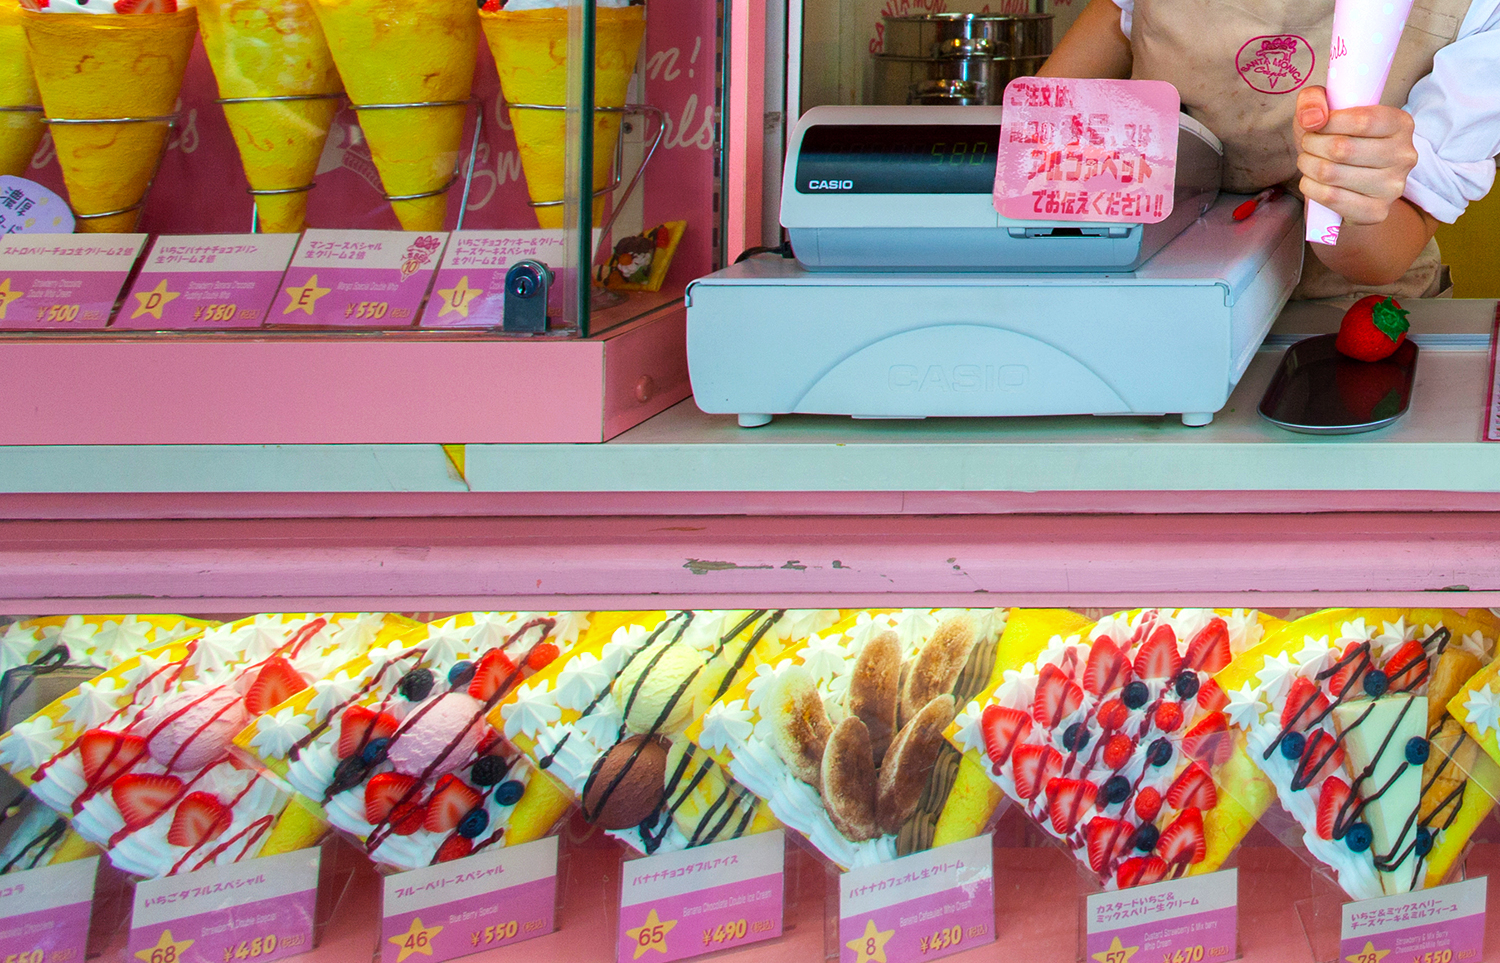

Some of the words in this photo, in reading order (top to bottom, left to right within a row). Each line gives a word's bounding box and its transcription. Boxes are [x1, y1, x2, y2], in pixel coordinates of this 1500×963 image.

[1240, 57, 1271, 73] SANTA
[1273, 57, 1302, 84] MONICA
[928, 141, 988, 168] 580
[1028, 150, 1153, 184] アルファベット
[808, 178, 854, 191] CASIO
[3, 246, 135, 257] ストロベリーチョコ生クリーム2倍
[159, 245, 259, 255] いちごバナナチョコプリン
[305, 250, 365, 260] 生クリーム2倍
[309, 240, 382, 251] マンゴースペシャル
[455, 247, 537, 256] チーズケーキスペシャル
[155, 254, 216, 264] 生クリーム2倍
[451, 256, 507, 265] 生クリーム2倍
[145, 293, 162, 310] D
[298, 288, 313, 304] E
[451, 289, 466, 307] U
[36, 304, 80, 322] ¥500
[193, 304, 237, 322] ¥580
[345, 301, 388, 320] ¥550
[887, 363, 1030, 393] CASIO
[633, 855, 739, 886] バナナチョコダブルアイス
[850, 860, 964, 898] バナナカフェオレ生クリーム
[145, 874, 265, 908] いちごダブルスペシャル
[395, 865, 505, 898] ブルーベリースペシャル
[682, 905, 702, 917] Banana
[703, 899, 728, 912] Chocolate
[728, 895, 746, 907] Double
[755, 889, 772, 901] Cream
[1096, 892, 1175, 914] カスタードいちご&
[1096, 897, 1199, 922] ミックスベリー生クリーム
[1351, 899, 1443, 922] いちご&ミックスベリー
[449, 914, 462, 924] Blue
[462, 910, 478, 922] Berry
[479, 905, 498, 917] Special
[900, 915, 918, 927] Banana
[943, 904, 955, 915] Whip
[956, 900, 973, 911] Cream
[1351, 904, 1458, 930] チーズケーキ&ミルフィーユ
[404, 931, 428, 949] 46
[471, 920, 519, 947] ¥550
[638, 924, 664, 947] 65
[702, 918, 748, 946] ¥490
[920, 924, 963, 954] ¥430
[1144, 930, 1163, 942] Custard
[1164, 925, 1190, 938] Strawberry
[151, 946, 176, 963] 68
[223, 935, 277, 962] ¥480
[866, 937, 876, 955] 8
[1144, 942, 1155, 951] Whip
[1156, 939, 1172, 949] Cream
[1163, 945, 1204, 963] ¥470
[1106, 951, 1126, 963] 57
